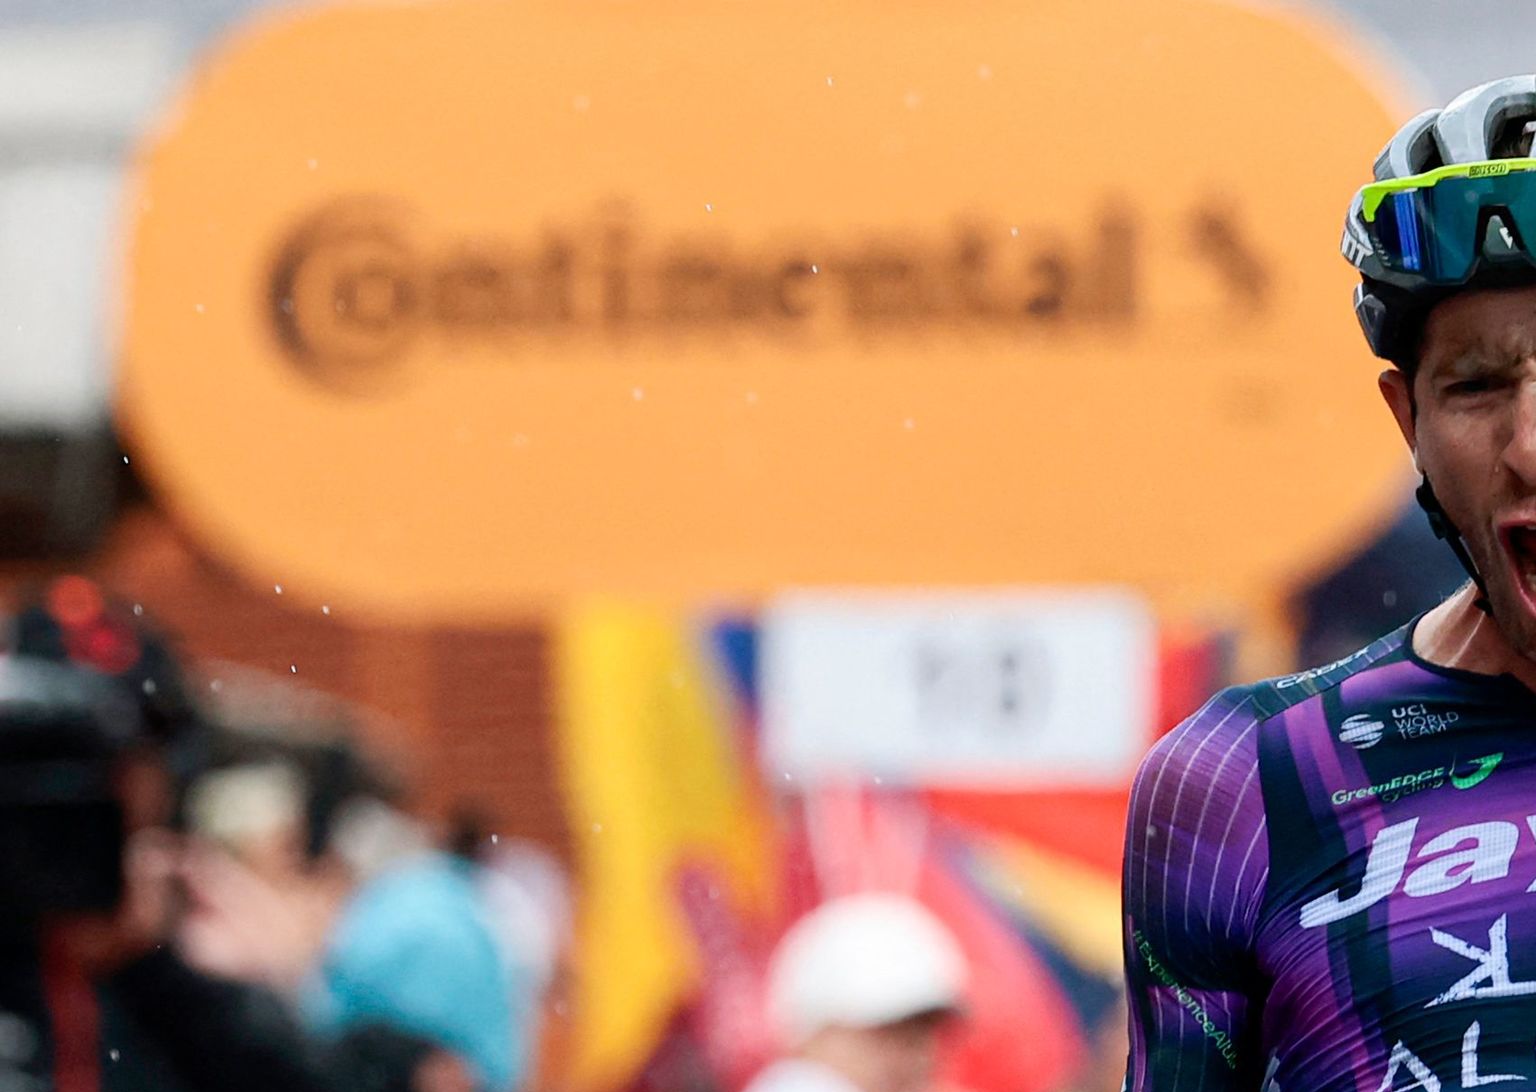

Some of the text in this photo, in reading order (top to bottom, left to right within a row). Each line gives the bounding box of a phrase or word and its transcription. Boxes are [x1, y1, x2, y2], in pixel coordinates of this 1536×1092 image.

[1392, 704, 1427, 718] UCI
[1395, 711, 1459, 731] WORLD
[1399, 723, 1447, 740] TEAM
[1332, 767, 1445, 805] GreenEDGE
